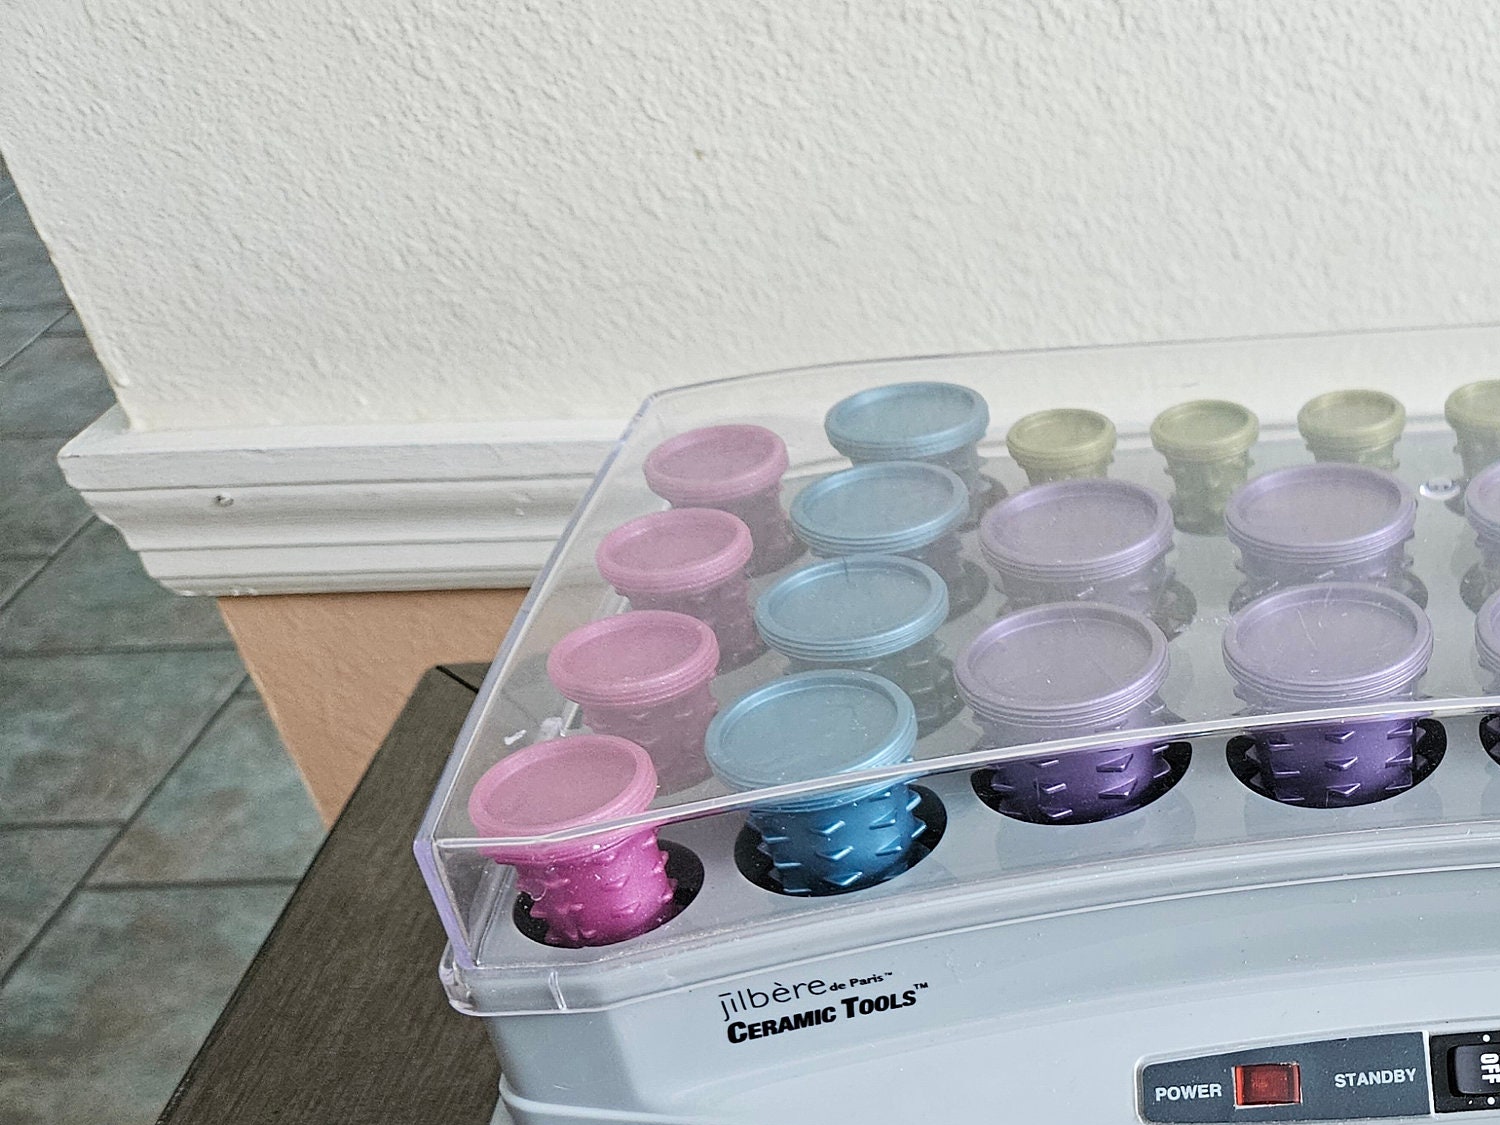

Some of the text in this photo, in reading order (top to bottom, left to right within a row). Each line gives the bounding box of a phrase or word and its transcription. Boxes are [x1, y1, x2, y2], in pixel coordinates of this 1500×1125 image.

[829, 981, 847, 992] de
[727, 1006, 837, 1044] CERAMIC
[1334, 1068, 1417, 1089] STANDBY
[1155, 1083, 1222, 1101] POWER
